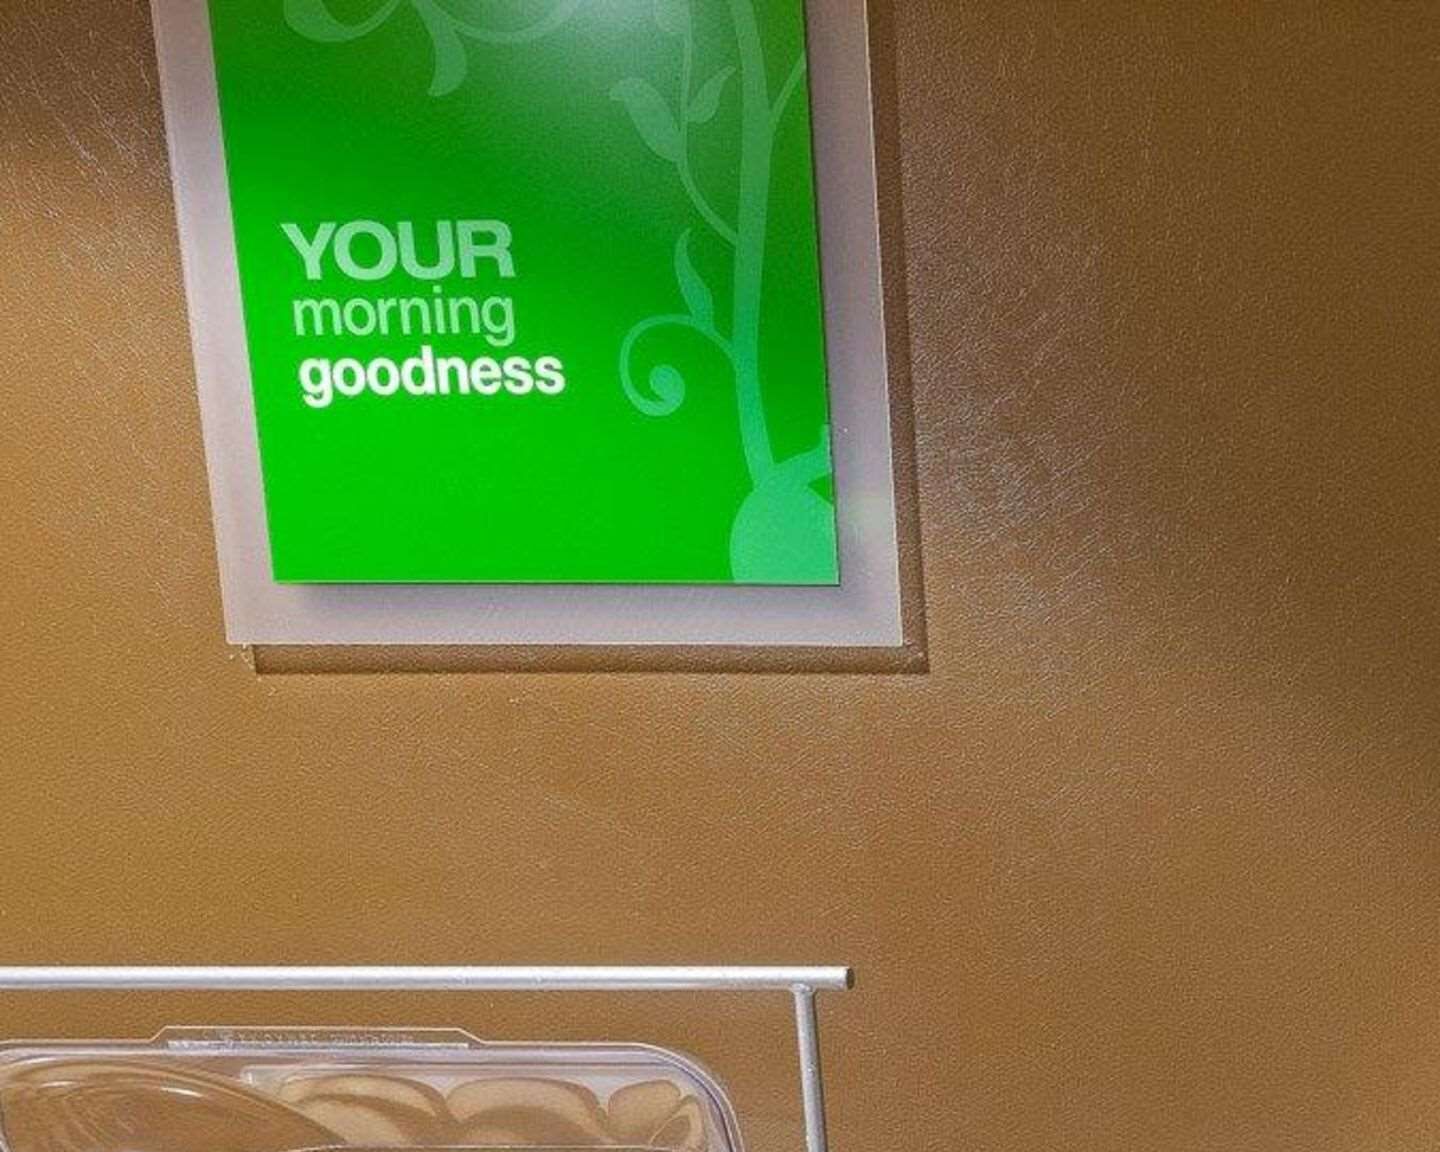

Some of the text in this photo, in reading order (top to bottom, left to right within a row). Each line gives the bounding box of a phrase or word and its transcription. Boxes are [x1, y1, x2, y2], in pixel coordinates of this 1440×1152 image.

[281, 219, 516, 280] YOUR
[292, 285, 516, 346] morning
[299, 345, 566, 408] goodness
